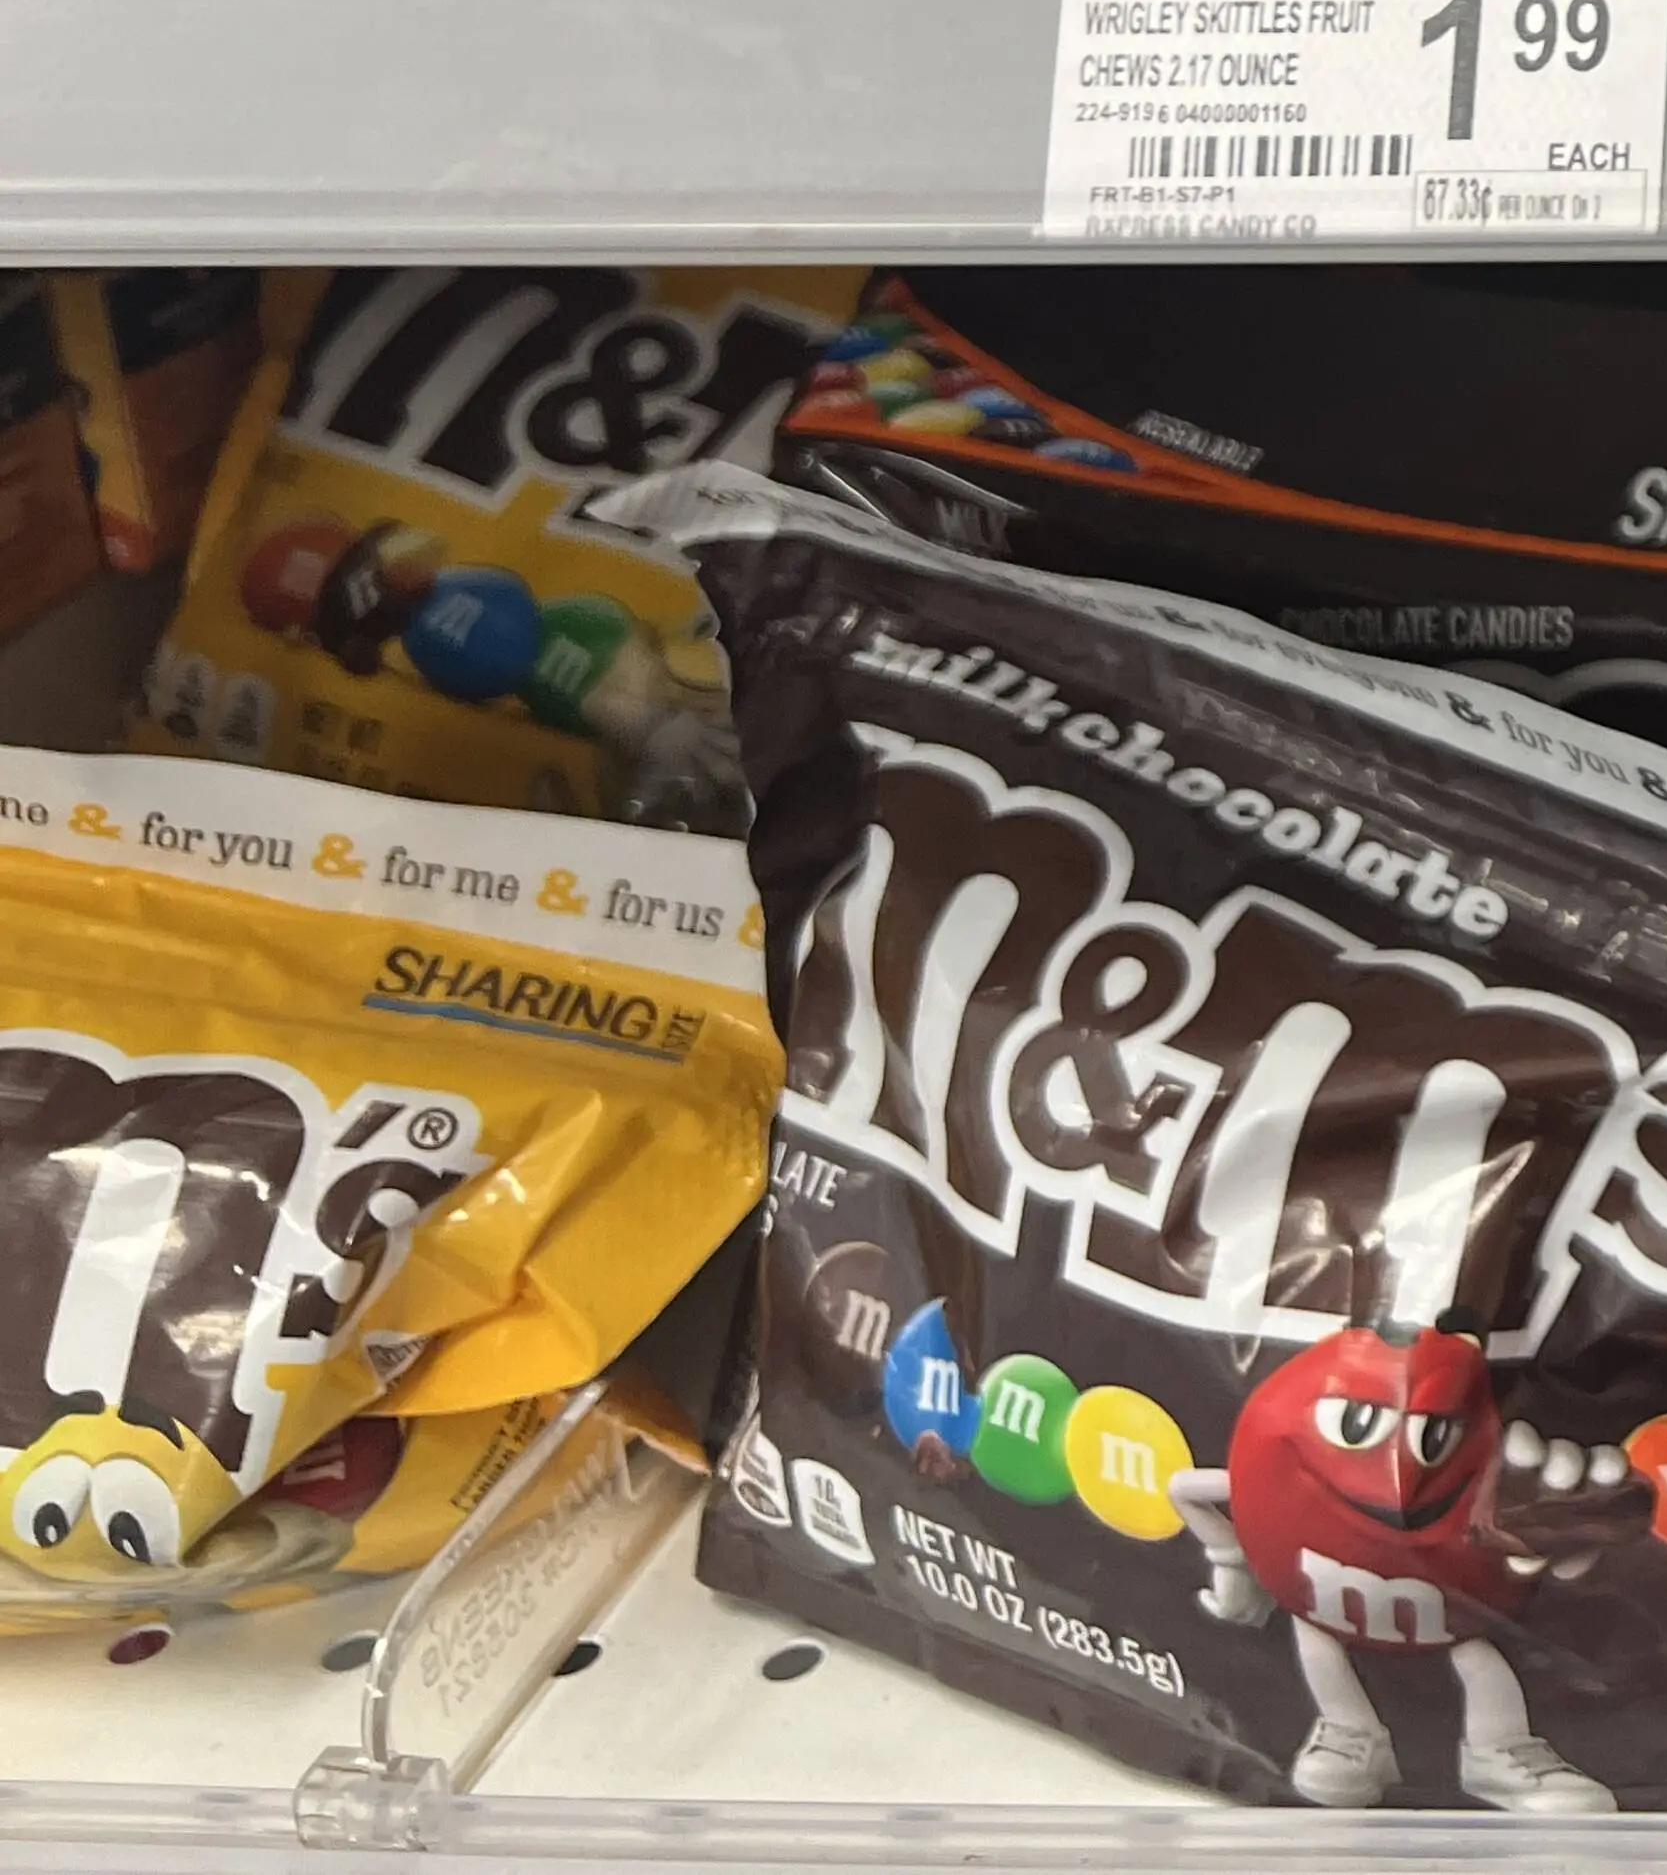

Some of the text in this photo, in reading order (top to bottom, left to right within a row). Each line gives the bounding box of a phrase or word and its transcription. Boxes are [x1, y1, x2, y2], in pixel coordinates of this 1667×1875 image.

[1083, 0, 1376, 35] WRIGLEY SKITTLES FRUIT
[1078, 52, 1301, 88] CHEWS 2.17 OUNCE
[1547, 142, 1631, 170] EACH
[1447, 605, 1576, 650] CANDIES
[848, 629, 1512, 940] milk chocolate
[1504, 711, 1557, 758] for
[1559, 733, 1631, 787] you
[137, 812, 206, 858] for
[215, 829, 295, 874] you
[379, 844, 448, 892] for
[452, 863, 522, 905] me
[602, 878, 671, 928] for
[673, 899, 726, 945] us
[373, 944, 660, 1043] SHARING
[892, 1505, 956, 1565] NET
[964, 1526, 1020, 1591] WT
[906, 1553, 1185, 1699] 10.0 OZ (283.5g)
